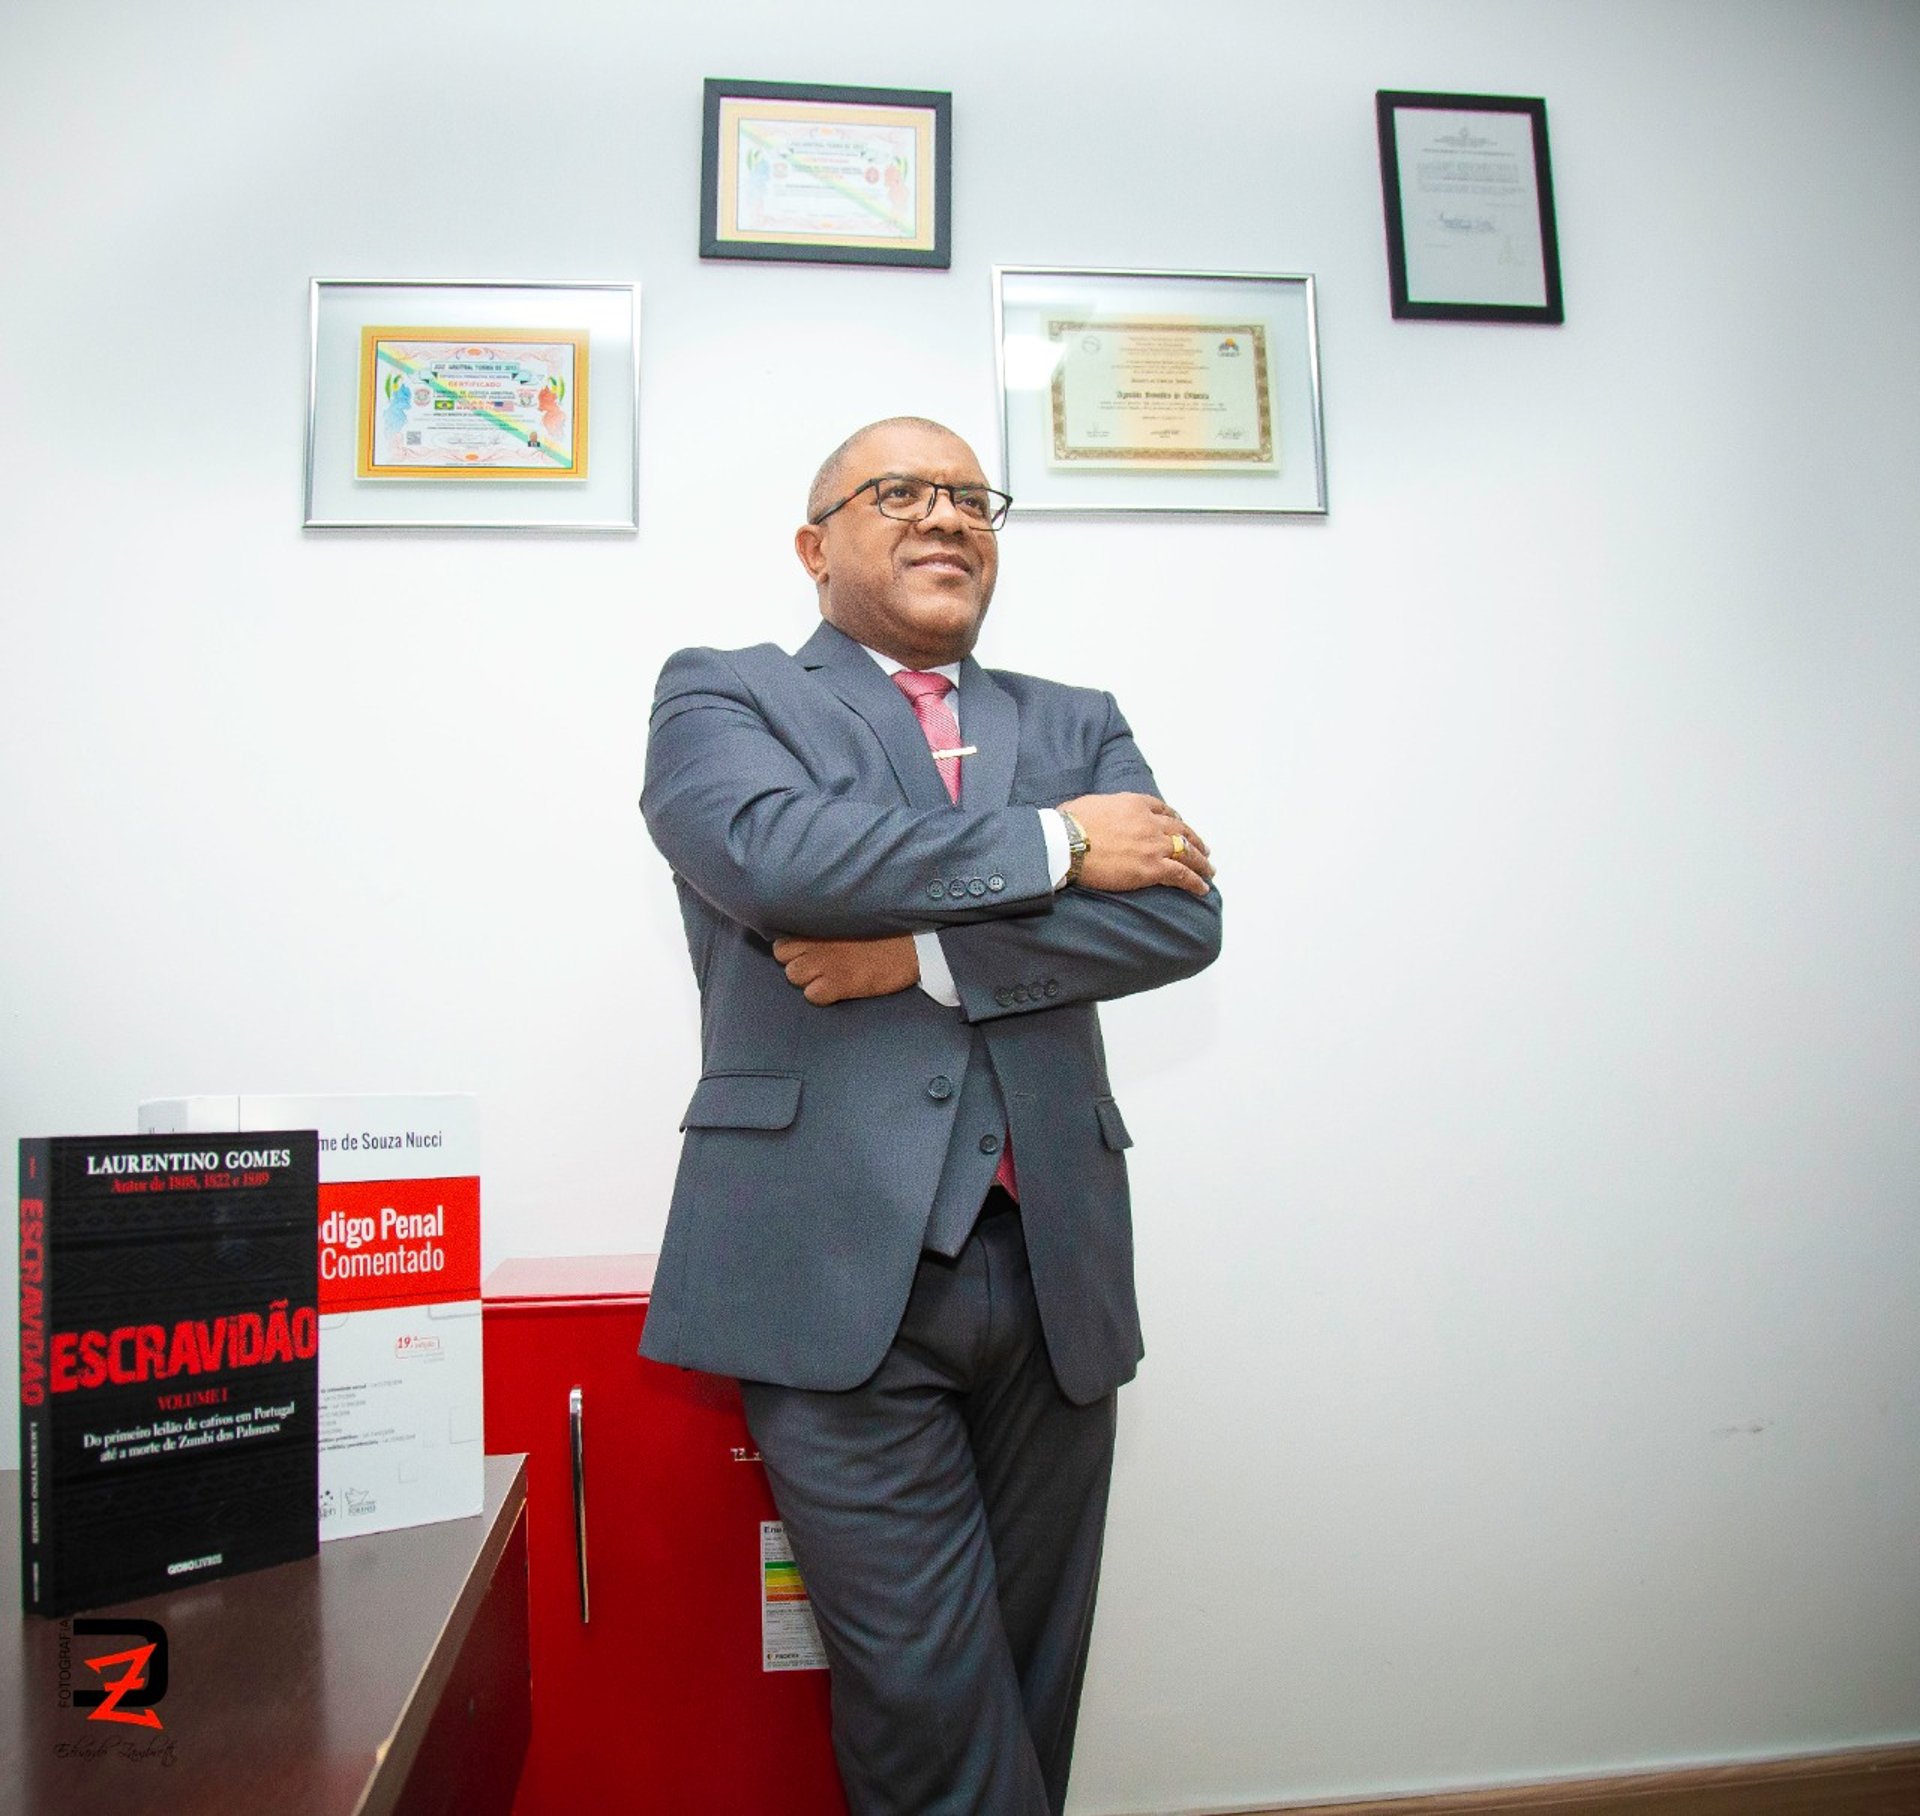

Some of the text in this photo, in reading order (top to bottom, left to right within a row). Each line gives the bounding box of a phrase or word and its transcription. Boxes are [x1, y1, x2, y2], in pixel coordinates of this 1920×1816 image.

[341, 1133, 358, 1151] de
[362, 1132, 402, 1150] Souza
[406, 1130, 442, 1148] Nucci
[87, 1149, 291, 1175] LAURENTINO GOMES
[318, 1204, 444, 1249] digo Penal
[321, 1241, 445, 1280] Comentado
[157, 1390, 219, 1411] VOLUME
[83, 1401, 295, 1449] Do primeiro leilão de cativos em Portugal
[100, 1420, 281, 1463] até a morte de Zumbi dos Palmares
